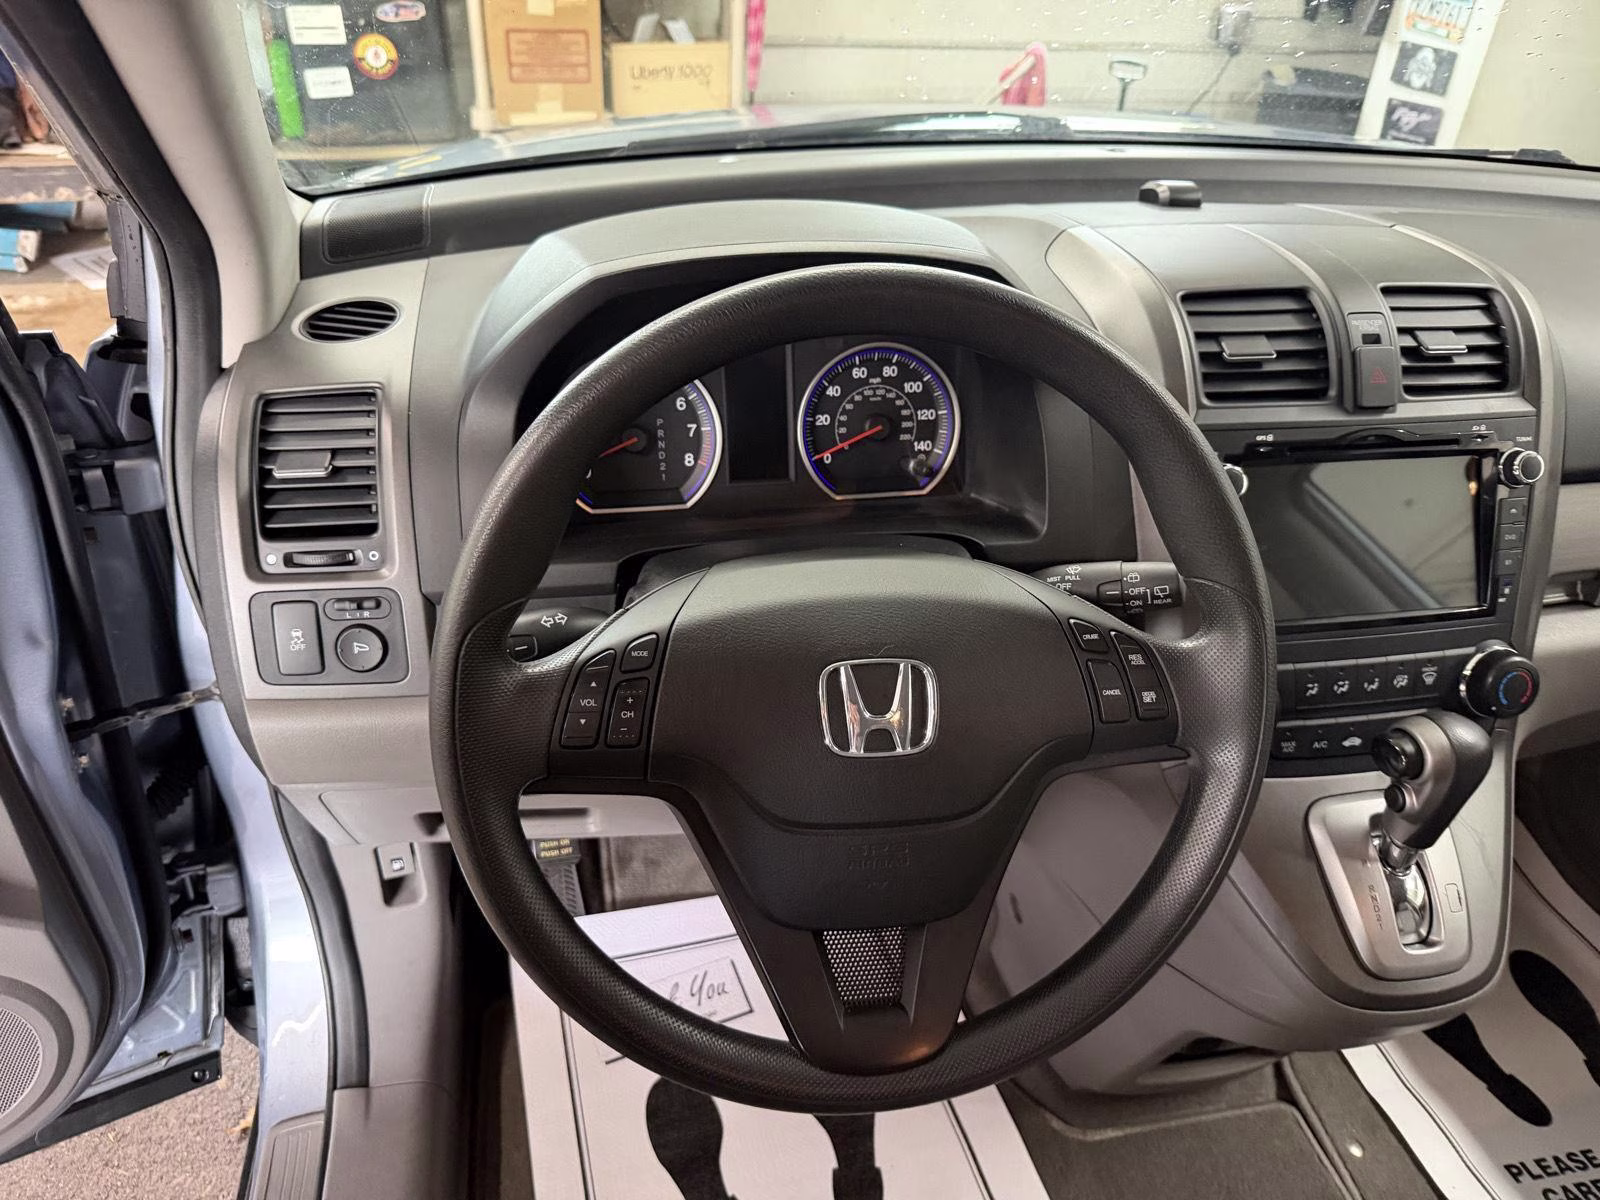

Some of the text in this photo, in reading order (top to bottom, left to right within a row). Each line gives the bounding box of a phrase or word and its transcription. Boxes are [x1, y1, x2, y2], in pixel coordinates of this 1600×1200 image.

[852, 367, 867, 378] 60
[883, 366, 898, 377] 80
[826, 385, 841, 397] 40
[904, 381, 923, 393] 100
[676, 397, 686, 411] 6
[816, 414, 831, 426] 20
[917, 409, 936, 420] 120
[657, 418, 664, 426] P
[657, 429, 665, 438] R
[687, 423, 697, 437] 7
[658, 441, 666, 449] N
[914, 440, 932, 452] 140
[659, 452, 666, 460] D
[684, 453, 695, 467] 8
[824, 453, 832, 464] 0
[660, 463, 667, 471] 2
[1055, 582, 1073, 591] OFF
[1128, 586, 1146, 596] OFF
[290, 643, 306, 652] OFF
[631, 650, 649, 658] MODE
[580, 698, 598, 707] VOL
[620, 710, 635, 719] CH
[1312, 740, 1328, 749] A/C
[689, 969, 730, 1006] You
[1503, 1148, 1600, 1184] PLEASE
